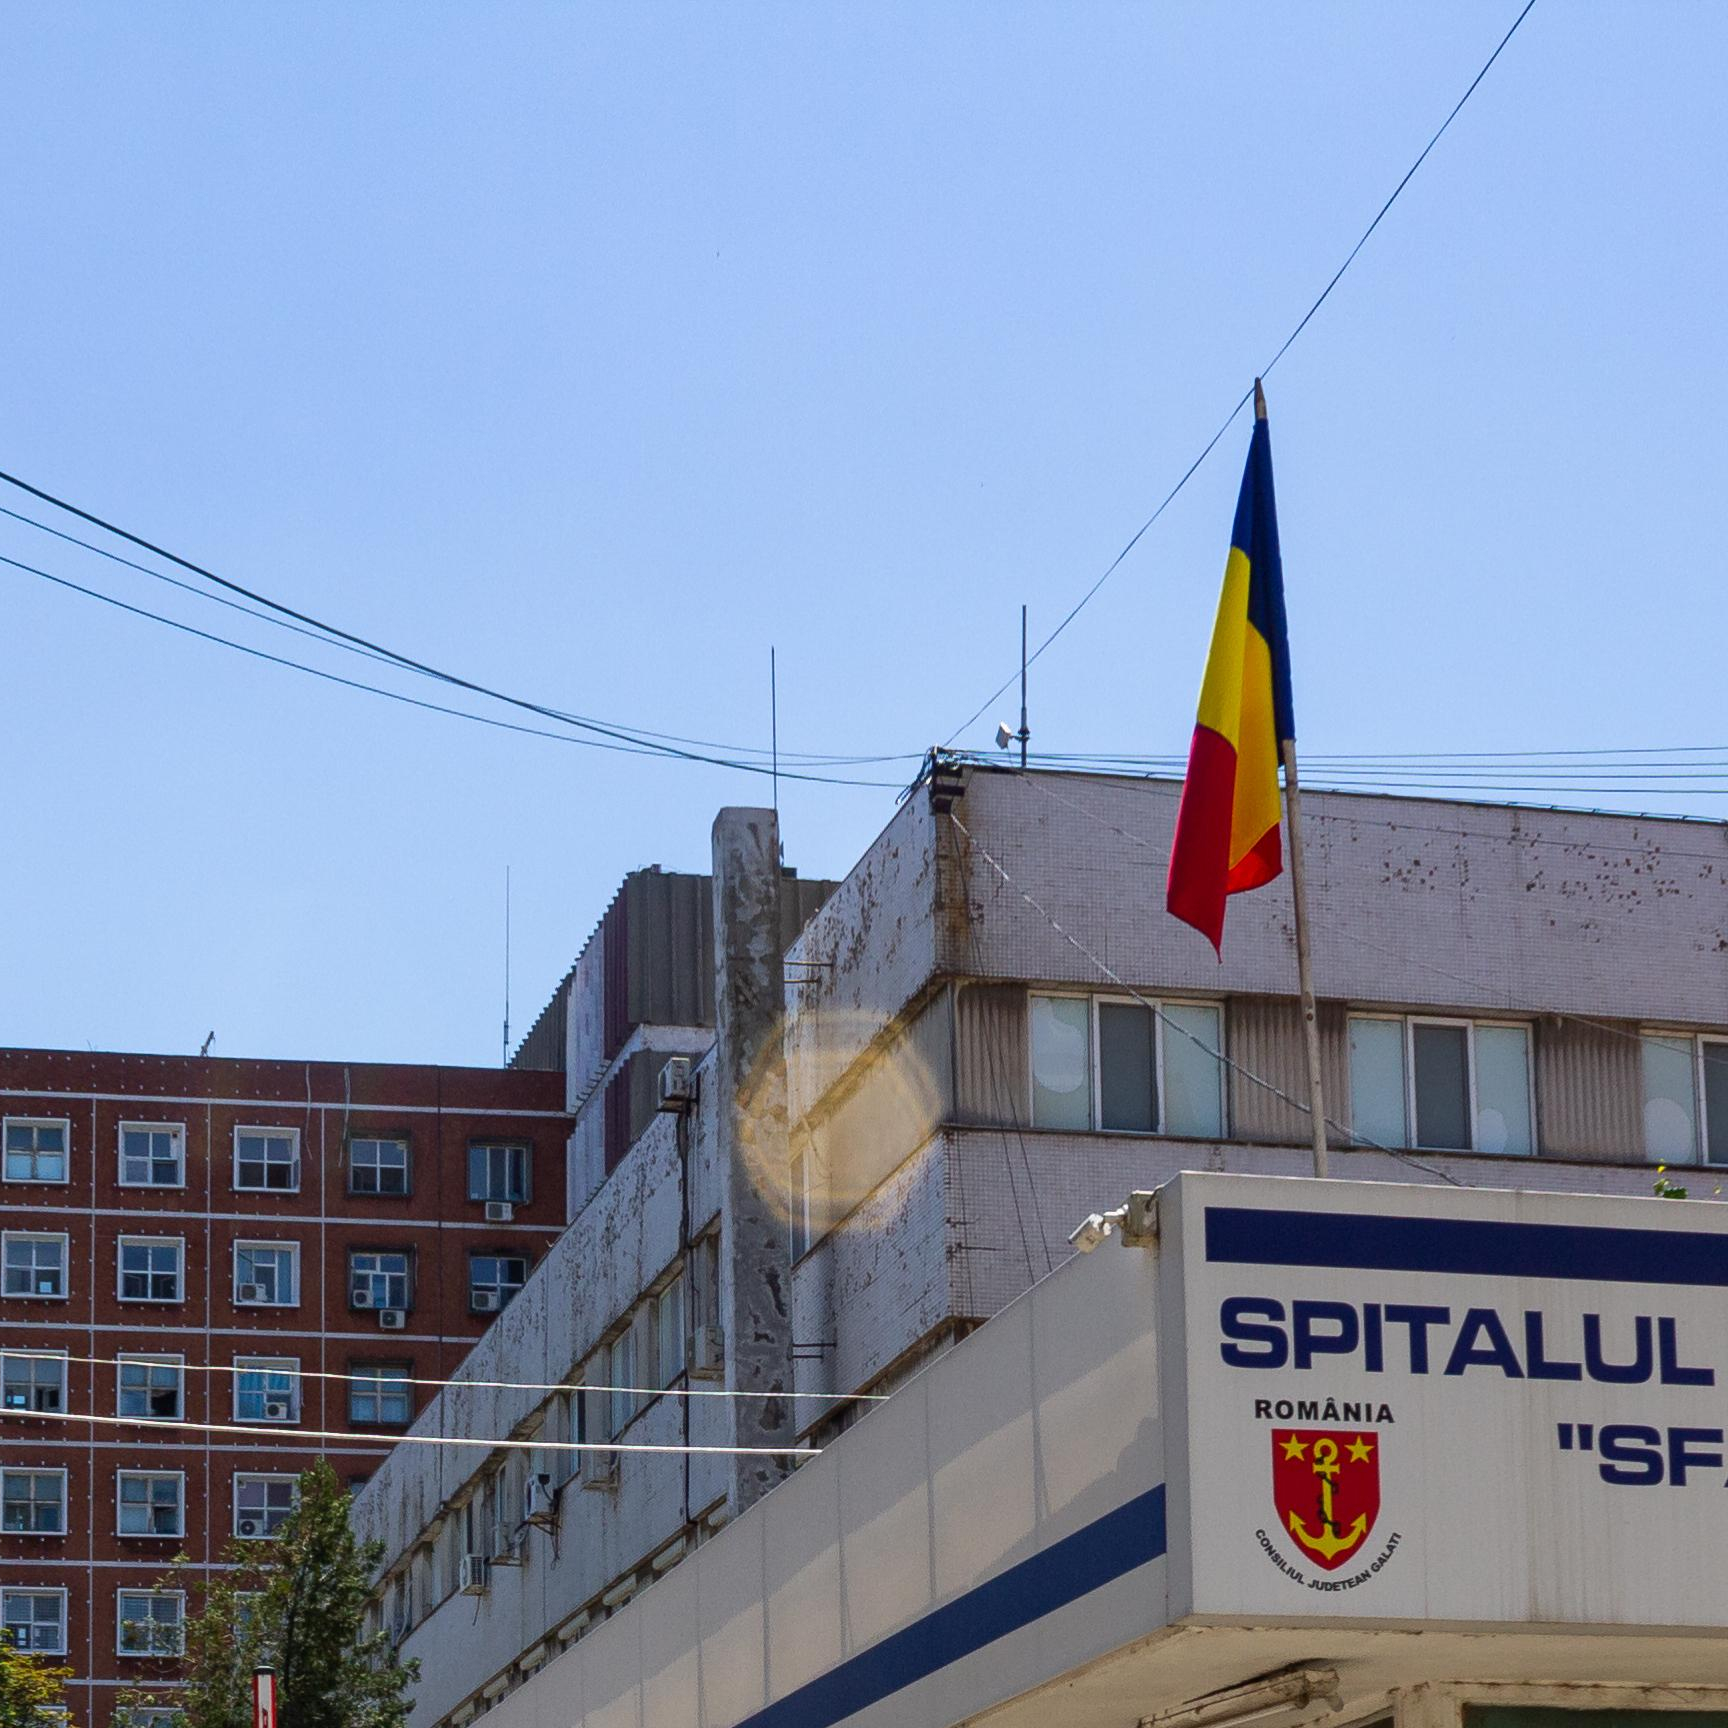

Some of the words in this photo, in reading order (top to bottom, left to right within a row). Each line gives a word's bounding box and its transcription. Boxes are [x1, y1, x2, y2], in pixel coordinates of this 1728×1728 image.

[1220, 1297, 1715, 1386] SPITALUL
[1254, 1397, 1395, 1423] ROMÂNIA
[1256, 1529, 1305, 1585] CONSILIUL
